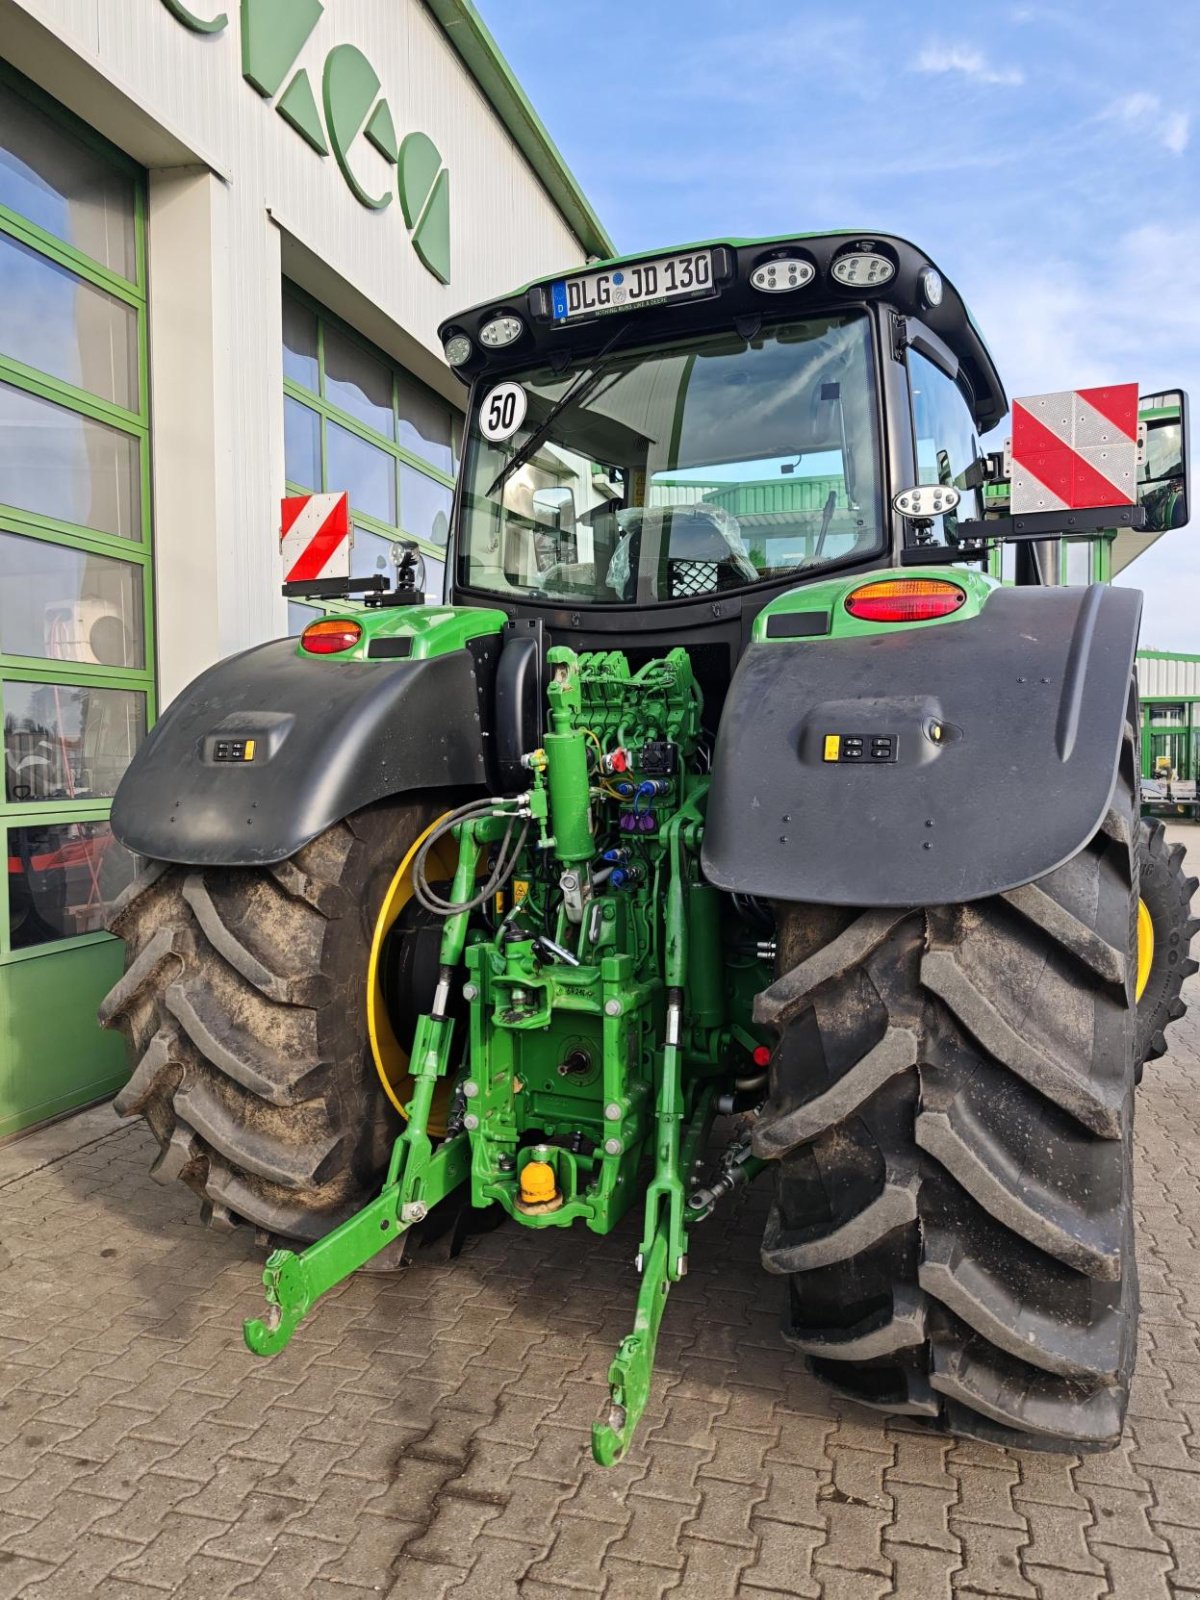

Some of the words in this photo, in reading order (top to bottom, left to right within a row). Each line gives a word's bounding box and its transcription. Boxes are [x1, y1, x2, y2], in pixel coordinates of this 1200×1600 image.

[567, 276, 611, 311] DLG
[629, 265, 658, 298] JD
[664, 254, 709, 292] 130
[557, 304, 564, 313] D
[488, 392, 516, 431] 50
